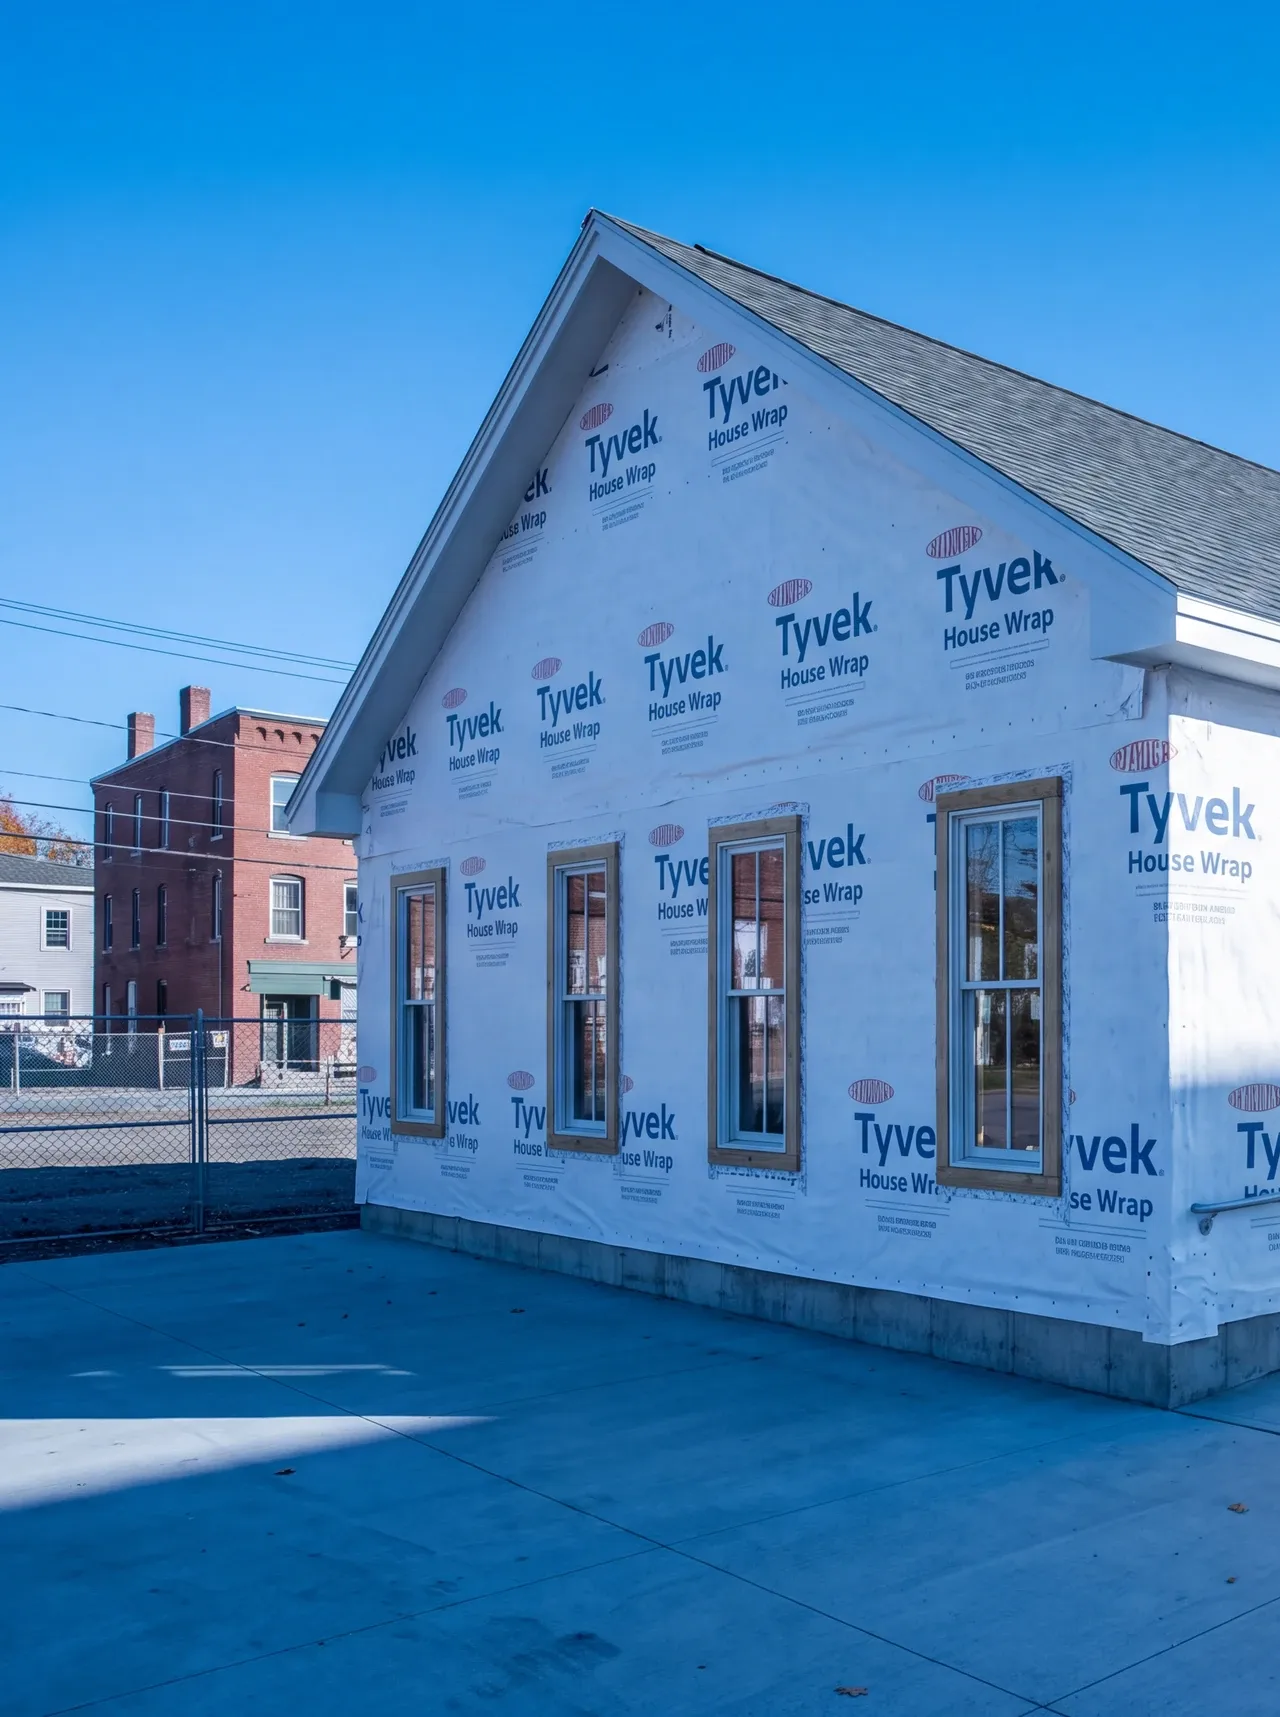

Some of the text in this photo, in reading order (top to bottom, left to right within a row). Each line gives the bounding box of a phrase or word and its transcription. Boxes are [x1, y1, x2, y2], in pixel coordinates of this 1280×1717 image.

[585, 408, 659, 478] Tyvek
[708, 404, 788, 451] House Wrap
[589, 461, 656, 502] House Wrap
[521, 510, 547, 532] Wrap
[936, 549, 1059, 621] Tyvek
[775, 592, 873, 663] Tyvek
[944, 608, 1054, 651] House Wrap
[644, 635, 724, 699] Tyvek
[780, 654, 869, 690] House Wrap
[536, 671, 603, 728] Tyvek
[648, 691, 722, 722] House Wrap
[446, 701, 502, 753] Tyvek
[540, 721, 601, 748] House Wrap
[379, 726, 417, 773] yvek
[449, 747, 500, 771] House Wrap
[396, 769, 416, 785] Wrap
[1119, 782, 1256, 844] Tyvek
[808, 823, 866, 871] vek
[1128, 850, 1252, 883] House Wrap
[655, 854, 709, 898] Tyve
[823, 882, 863, 905] Wrap
[464, 876, 520, 920] Tyvek
[658, 901, 694, 921] House
[467, 920, 518, 938] House Wrap
[360, 1088, 391, 1125] Tyve
[448, 1093, 480, 1126] vek
[511, 1096, 546, 1139] Tyv
[622, 1103, 676, 1146] yvek
[456, 1133, 479, 1154] Wrap
[513, 1138, 542, 1157] House
[854, 1112, 936, 1167] Tyve
[1069, 1123, 1158, 1177] vek
[622, 1150, 673, 1173] use Wrap
[859, 1168, 939, 1195] House Wr
[1097, 1188, 1153, 1222] Wrap
